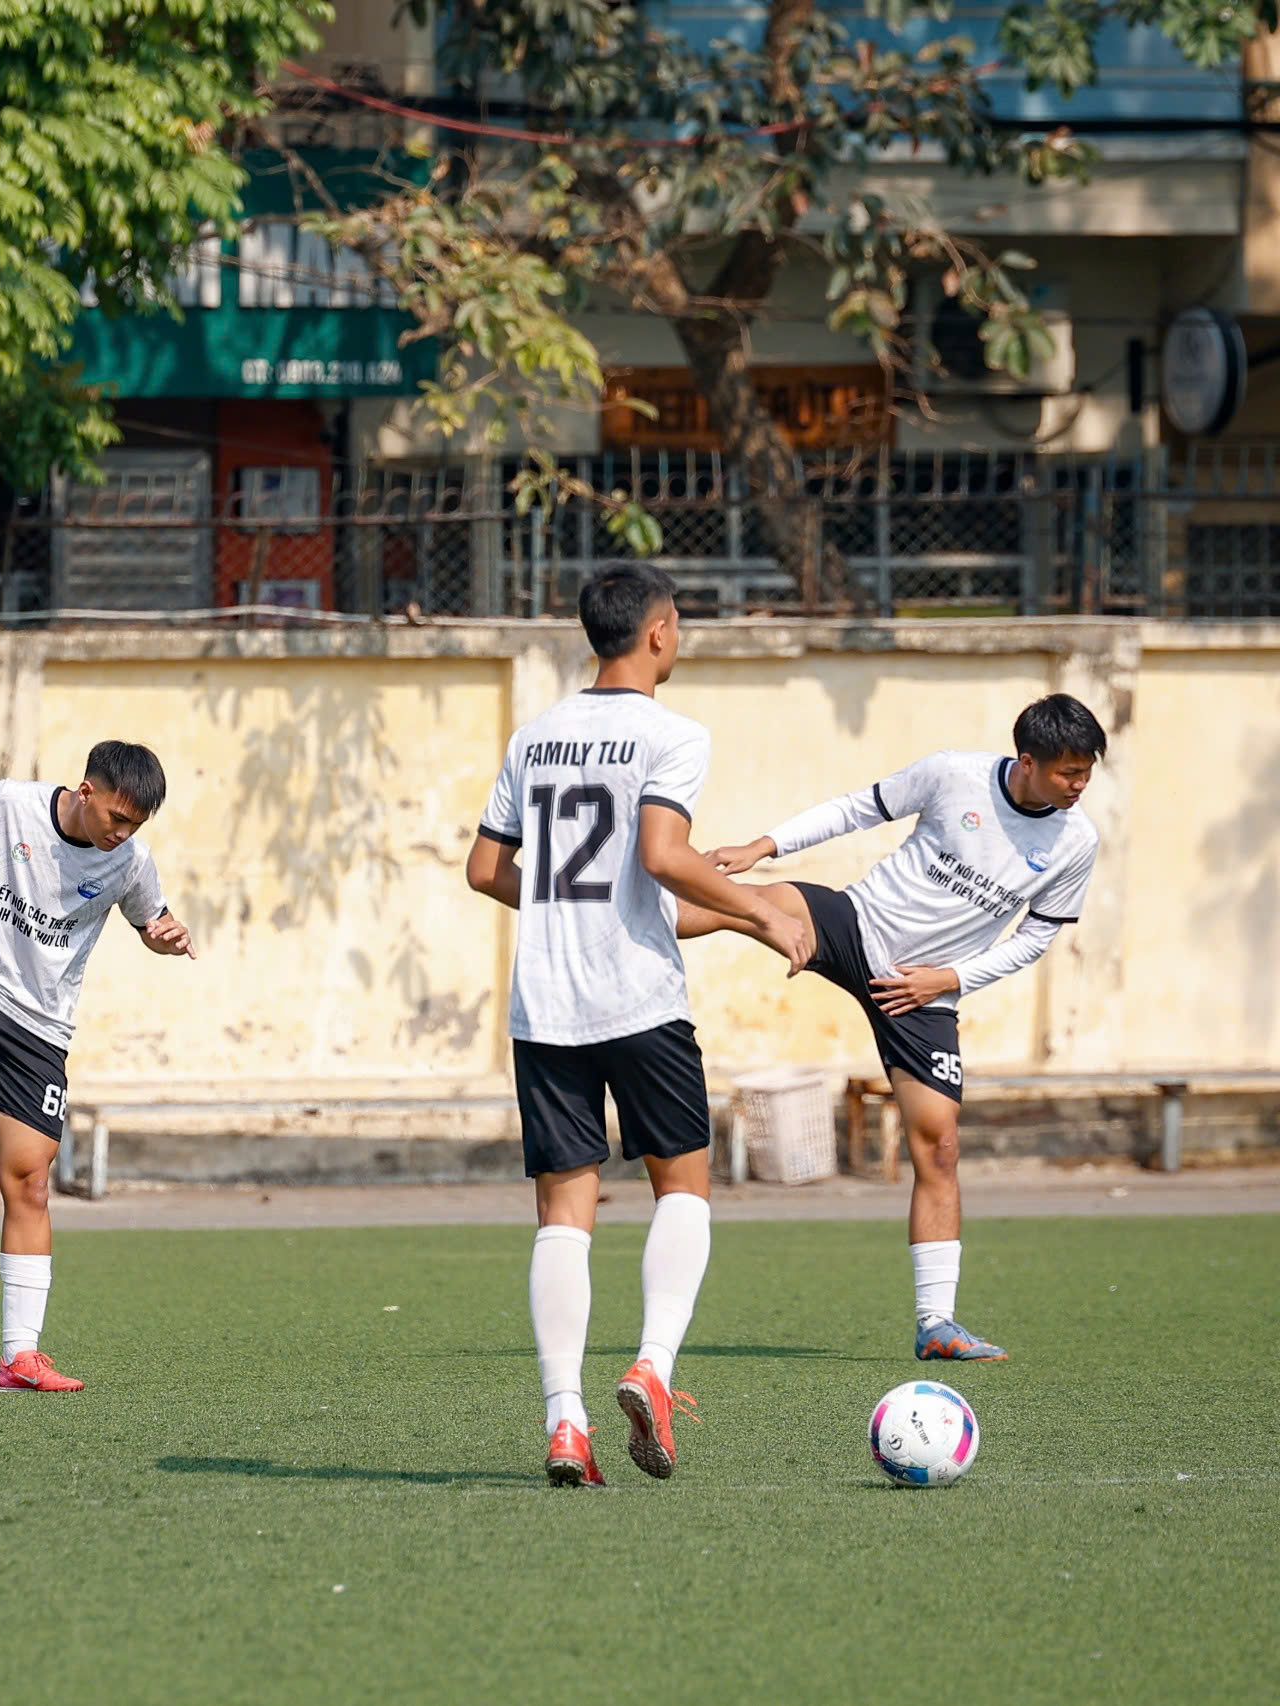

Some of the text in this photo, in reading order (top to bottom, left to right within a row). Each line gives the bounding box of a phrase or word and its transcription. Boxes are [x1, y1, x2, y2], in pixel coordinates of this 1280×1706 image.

[524, 740, 636, 768] FAMILY TLU
[528, 783, 615, 904] 12
[927, 864, 952, 889] SINH
[938, 850, 957, 869] KẾT
[954, 862, 976, 881] NỐI
[11, 894, 27, 914] NỐI
[27, 905, 48, 925] CÁC
[12, 912, 32, 938] VIÊN
[931, 1050, 962, 1086] 35
